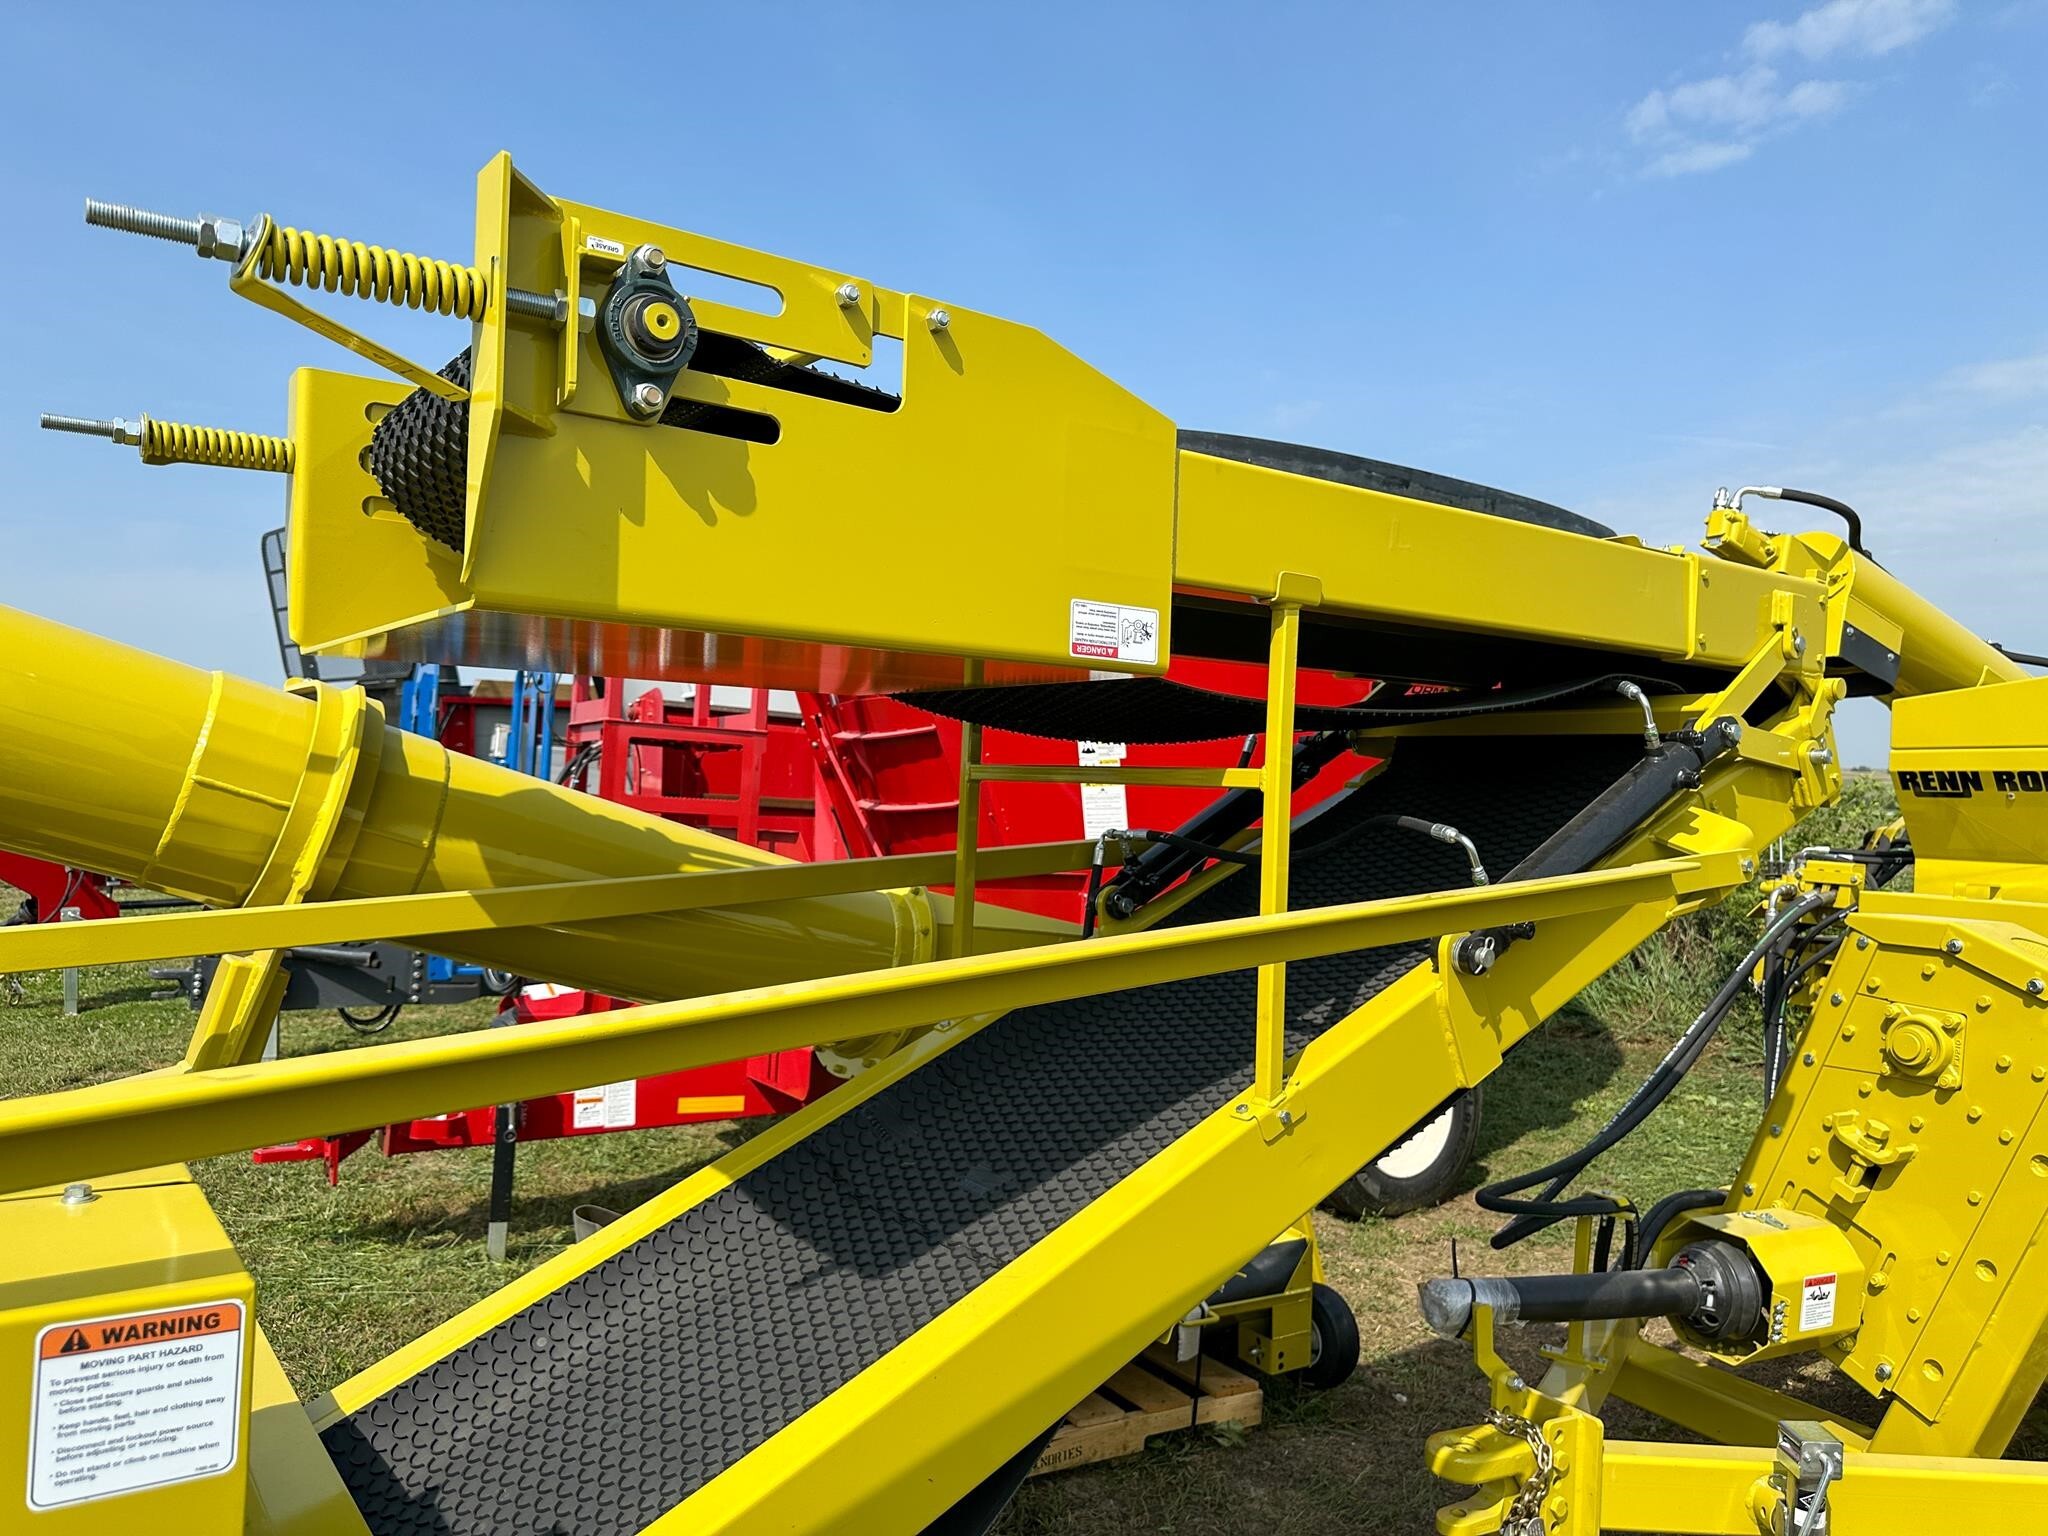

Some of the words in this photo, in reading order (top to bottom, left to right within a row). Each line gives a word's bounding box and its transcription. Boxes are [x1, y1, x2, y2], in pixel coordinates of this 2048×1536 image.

[595, 242, 619, 253] GREASE
[1077, 644, 1107, 655] DANGER
[1897, 771, 1984, 797] RENN
[102, 1312, 221, 1344] WARNING
[80, 1356, 125, 1369] MOVING
[128, 1351, 156, 1361] PART
[159, 1344, 203, 1357] HAZARD
[64, 1373, 99, 1386] prevent
[102, 1368, 135, 1378] serious
[138, 1363, 164, 1373] injury
[178, 1357, 202, 1366] death
[205, 1353, 224, 1362] from
[49, 1386, 84, 1396] moving
[59, 1398, 84, 1406] Close
[87, 1393, 103, 1401] and
[105, 1390, 133, 1399] secure
[136, 1383, 165, 1395] guards
[167, 1380, 182, 1389] and
[184, 1376, 213, 1385] shields
[58, 1405, 86, 1415] before
[58, 1422, 80, 1431] Keep
[153, 1405, 168, 1414] and
[170, 1400, 203, 1410] clothing
[205, 1396, 225, 1404] away
[56, 1440, 106, 1454] Disconnect
[107, 1436, 123, 1445] and
[126, 1430, 157, 1441] lockout
[159, 1426, 184, 1436] power
[186, 1420, 214, 1430] source
[57, 1430, 77, 1438] from
[80, 1424, 112, 1434] moving
[56, 1453, 83, 1462] before
[86, 1445, 126, 1456] adjusting
[70, 1467, 84, 1475] not
[87, 1462, 111, 1472] stand
[123, 1455, 147, 1464] climb
[162, 1445, 196, 1457] machine
[198, 1441, 220, 1450] when
